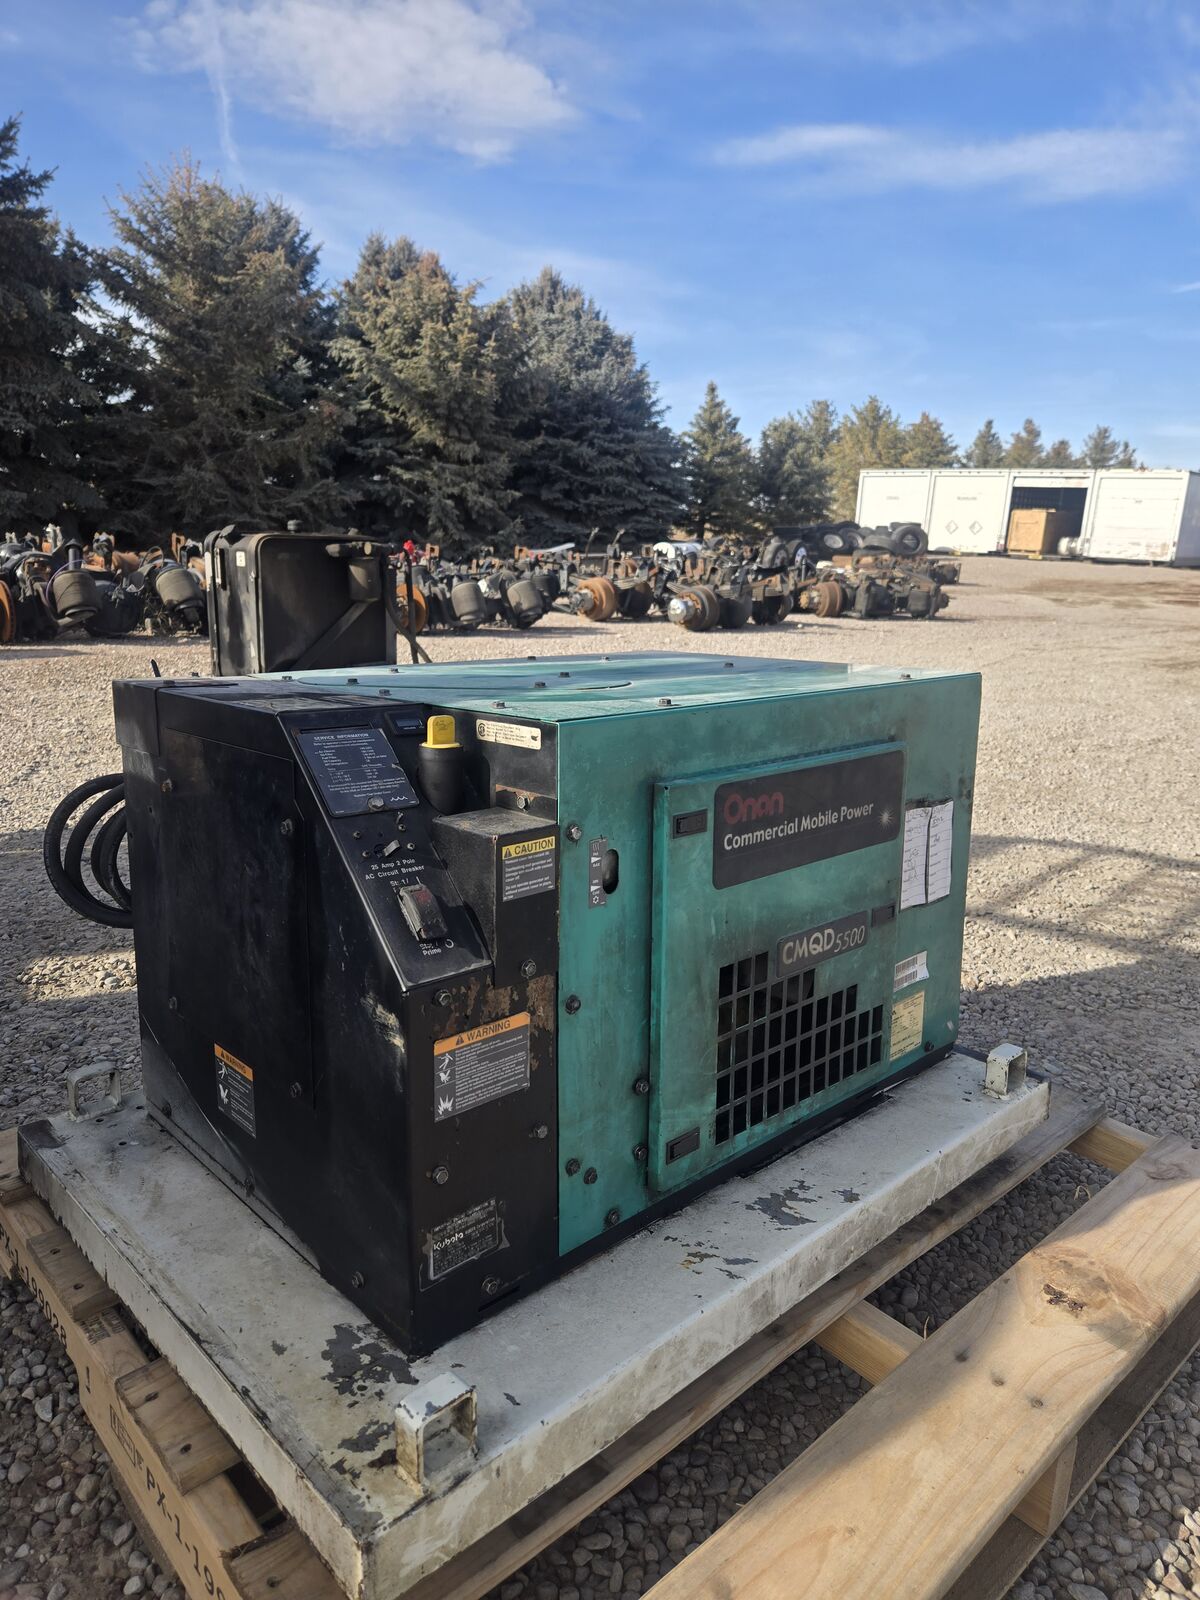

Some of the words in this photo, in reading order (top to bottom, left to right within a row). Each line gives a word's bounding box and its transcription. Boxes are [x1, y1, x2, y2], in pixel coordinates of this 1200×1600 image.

[723, 791, 785, 825] Onan
[723, 817, 798, 851] Commercial
[800, 810, 838, 832] Mobile
[840, 802, 875, 823] Power
[514, 838, 554, 855] CAUTION
[377, 869, 399, 878] Circuit
[400, 865, 425, 874] Breaker
[422, 948, 442, 956] Prime
[466, 1019, 511, 1042] WARNING
[225, 1053, 247, 1074] WARNING
[433, 1232, 464, 1250] Kubota
